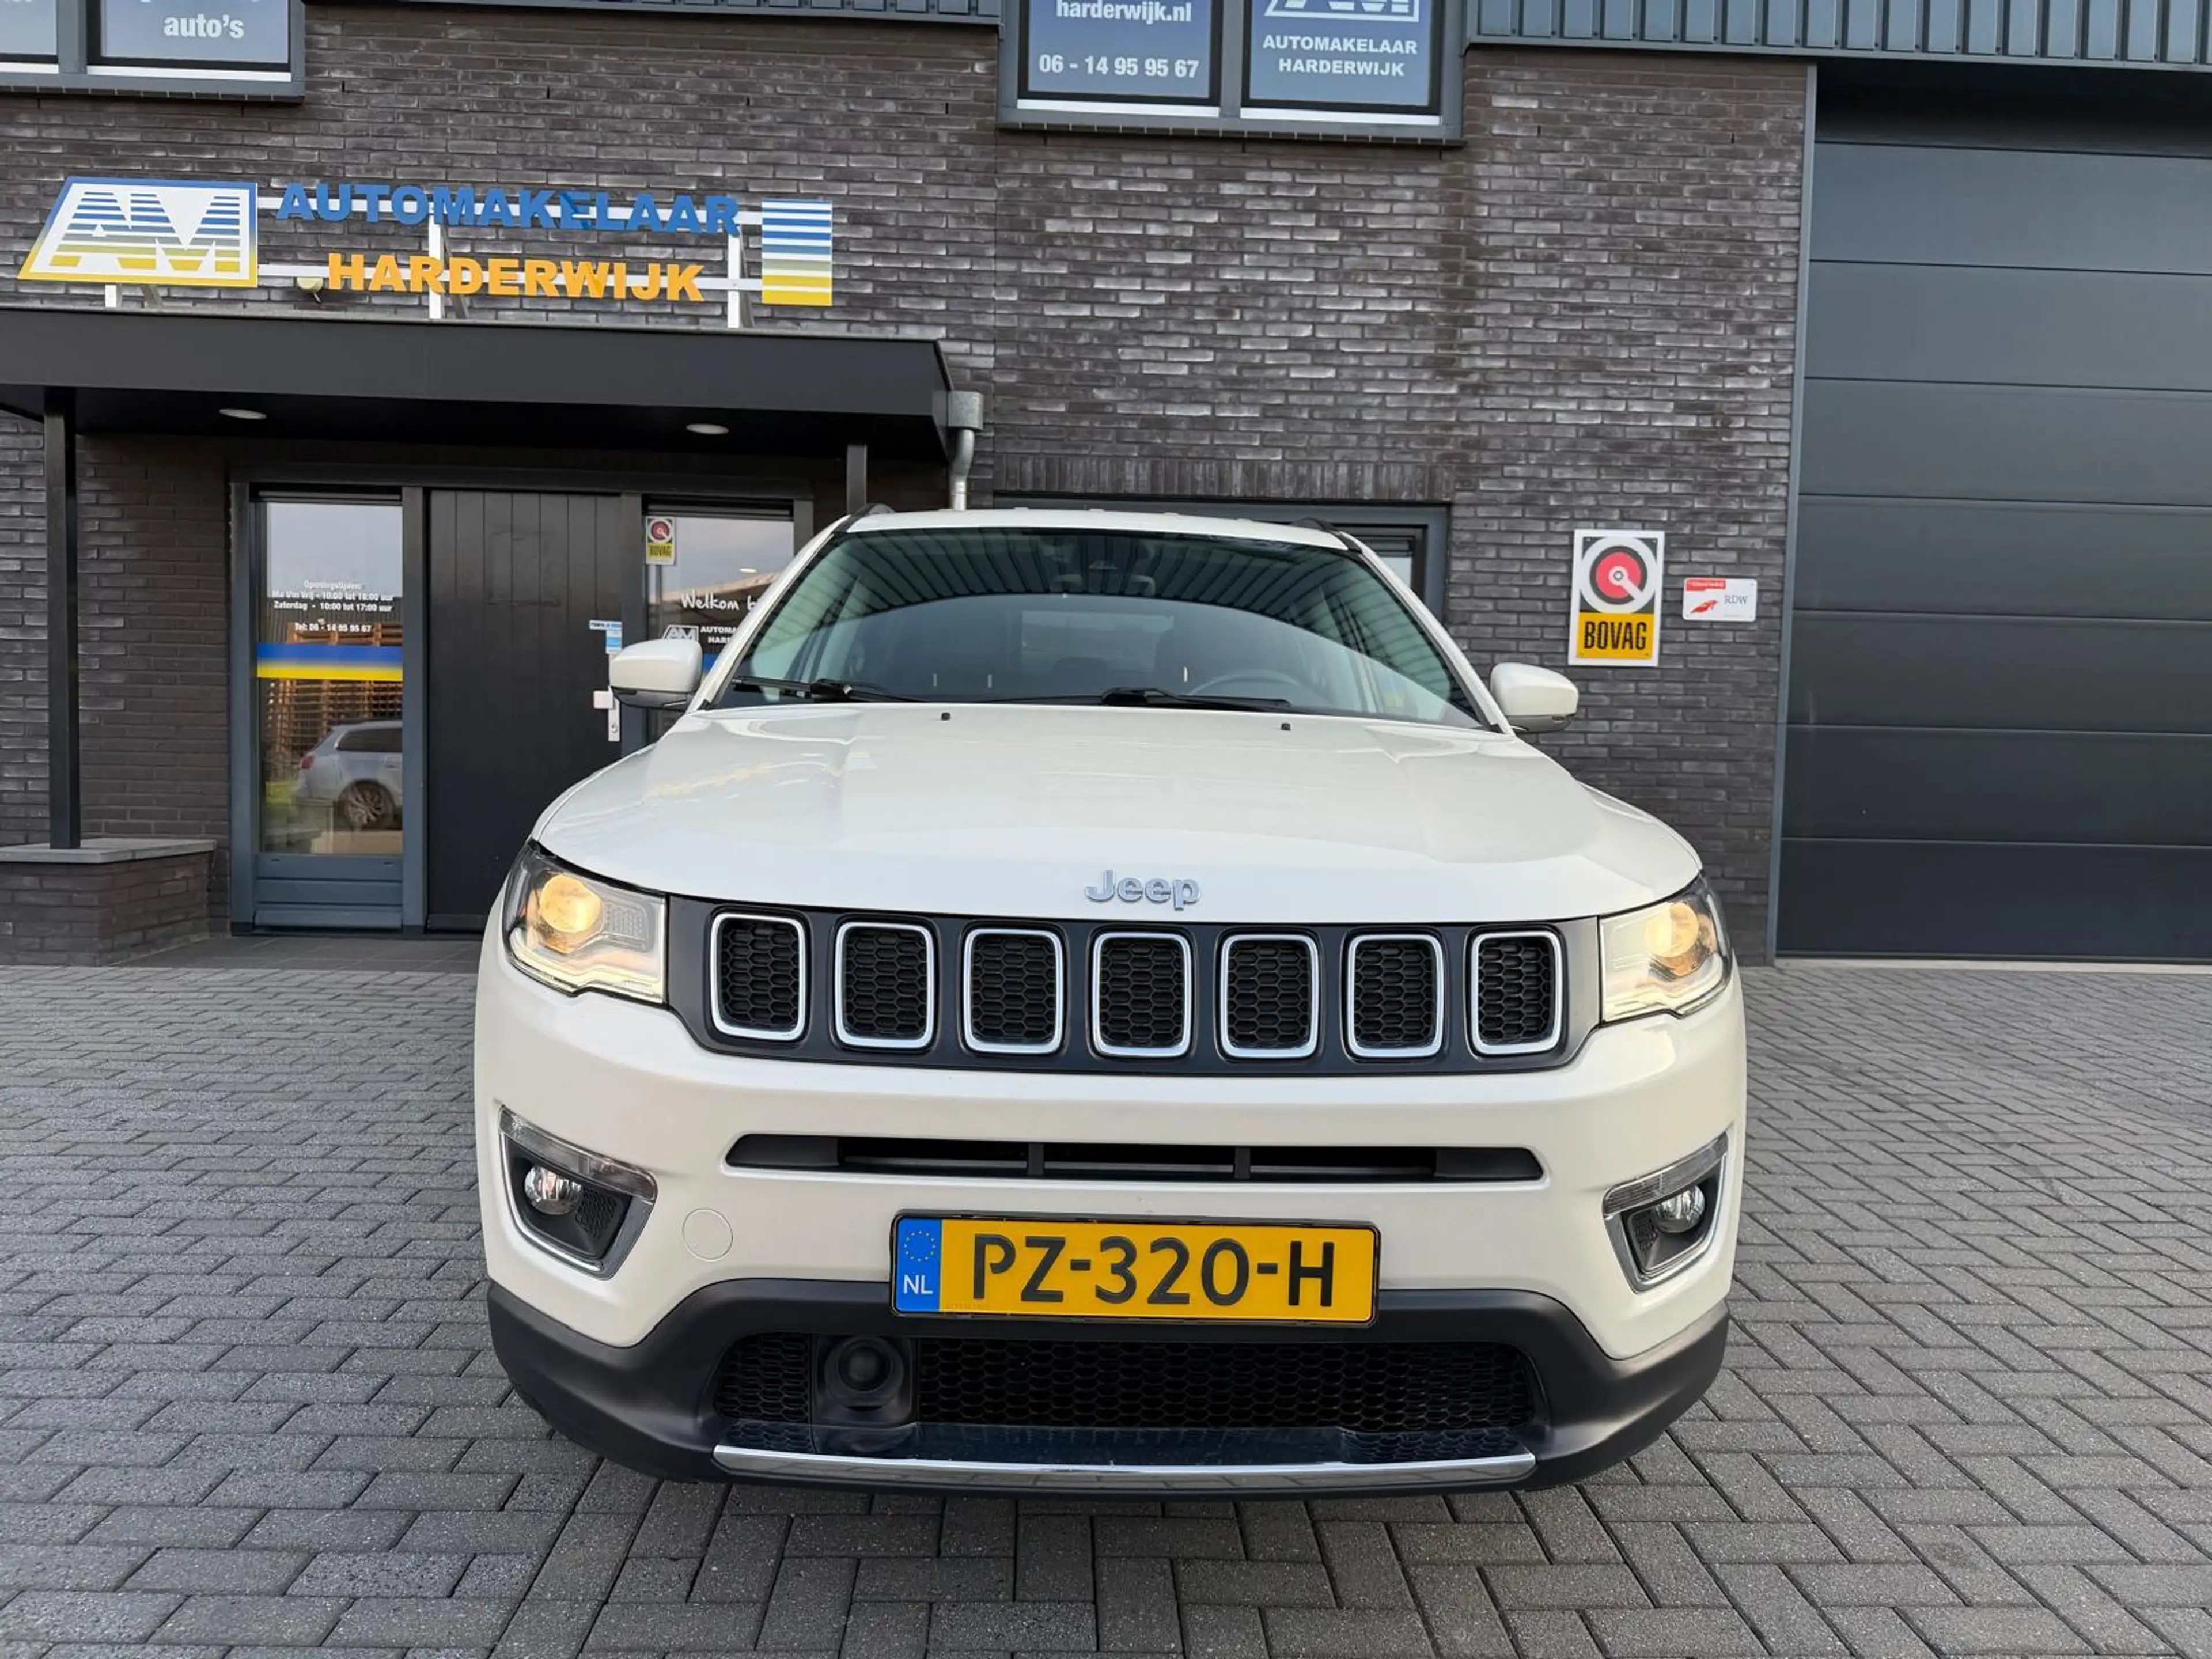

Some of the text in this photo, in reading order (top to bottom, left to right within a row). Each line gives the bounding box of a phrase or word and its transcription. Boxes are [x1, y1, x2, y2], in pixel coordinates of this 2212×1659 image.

[1056, 0, 1192, 24] harderwijk.nl
[164, 13, 244, 39] auto's
[1262, 35, 1418, 55] AUTOMAKELAAR
[1039, 54, 1064, 73] 06
[1085, 56, 1109, 75] 14
[1114, 57, 1139, 76] 95
[1145, 58, 1168, 77] 95
[1175, 60, 1199, 78] 67
[1279, 58, 1405, 77] HARDERWIJK
[276, 183, 740, 237] AUTOMAKELAAR
[328, 252, 704, 302] HARDERWIJK
[681, 589, 740, 611] Welkom
[1584, 620, 1647, 650] BOVAG
[1084, 869, 1201, 911] Jeep
[972, 1233, 1335, 1308] PZ-320-H
[903, 1274, 933, 1295] NL
